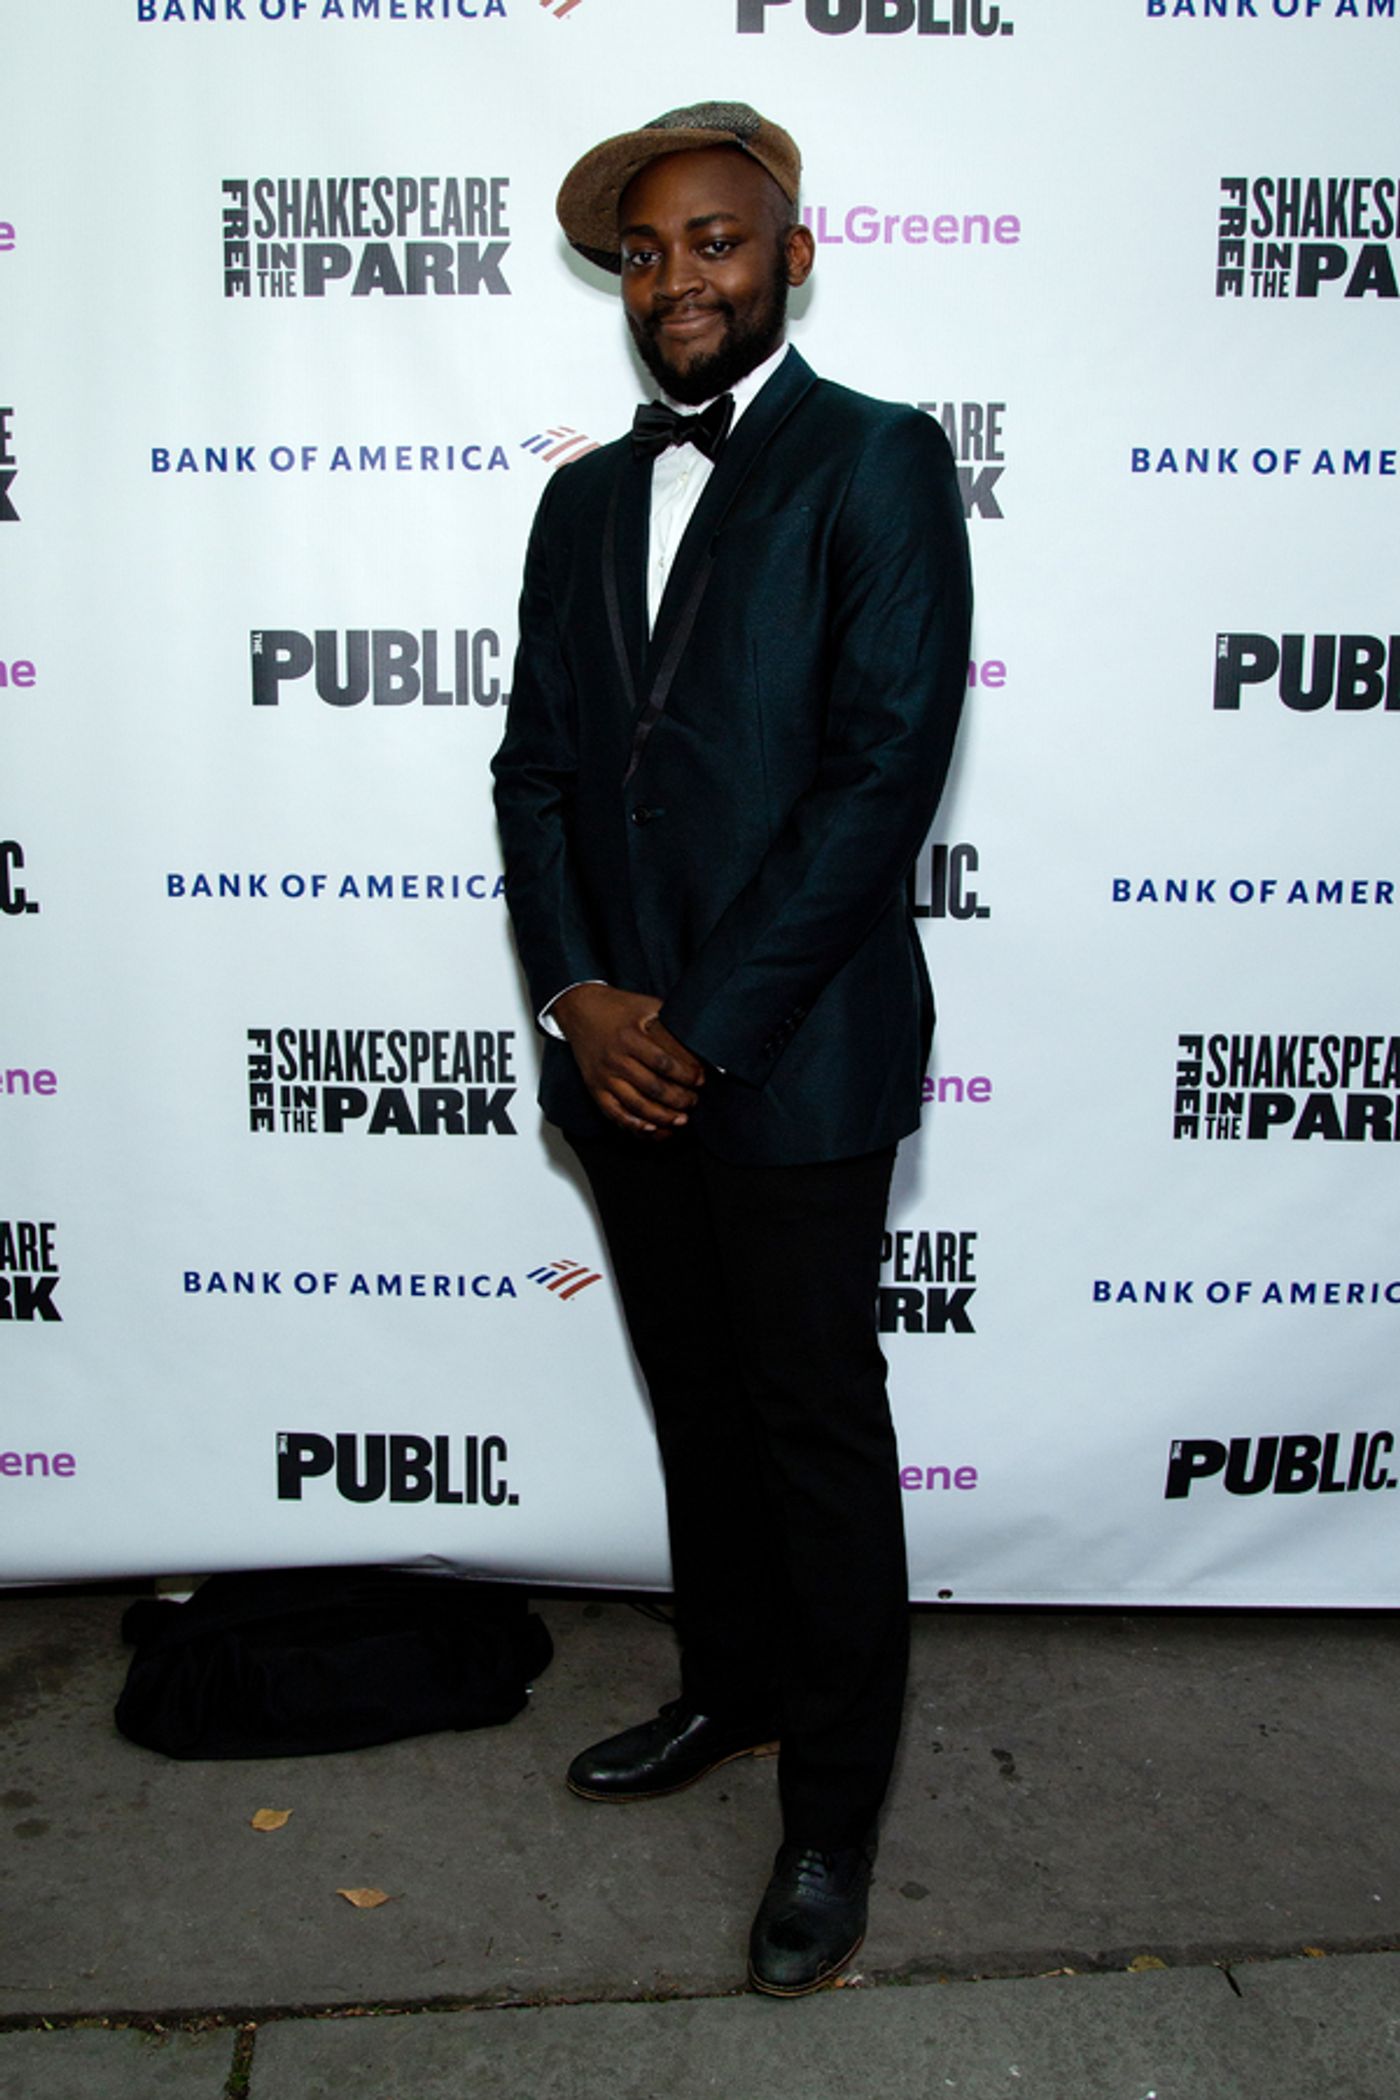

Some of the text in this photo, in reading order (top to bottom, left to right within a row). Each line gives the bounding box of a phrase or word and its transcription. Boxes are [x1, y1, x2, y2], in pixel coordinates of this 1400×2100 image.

[137, 0, 506, 22] BANK OF AMERICA
[1147, 0, 1258, 18] BANK
[1272, 0, 1322, 18] OF
[254, 176, 510, 239] SHAKESPEARE
[1251, 176, 1400, 239] SHAKES
[222, 179, 250, 297] FREE
[1216, 177, 1249, 297] FREE
[256, 242, 297, 270] IN
[302, 241, 512, 297] PARK
[1251, 242, 1294, 270] IN
[256, 271, 297, 298] THE
[1250, 270, 1291, 298] THE
[152, 446, 509, 473] BANK OF AMERICA
[1132, 448, 1398, 475] BANK OF AME
[250, 628, 511, 707] PUBLIC.
[167, 873, 506, 899] BANK OF AMERICA
[1112, 878, 1395, 905] BANK OF AMER
[276, 1027, 517, 1084] SHAKESPEARE
[247, 1028, 276, 1133] FREE
[1173, 1034, 1205, 1140] FREE
[280, 1086, 318, 1110] IN
[322, 1086, 519, 1135] PARK
[1205, 1092, 1244, 1115] IN
[280, 1111, 318, 1133] THE
[1204, 1117, 1242, 1140] THE
[1246, 1092, 1400, 1142] PAR
[183, 1271, 517, 1298] BANK OF AMERICA
[1093, 1280, 1400, 1305] BANK OF AMERIC
[276, 1431, 520, 1507] PUBLIC.
[1165, 1430, 1398, 1499] PUBLIC.
